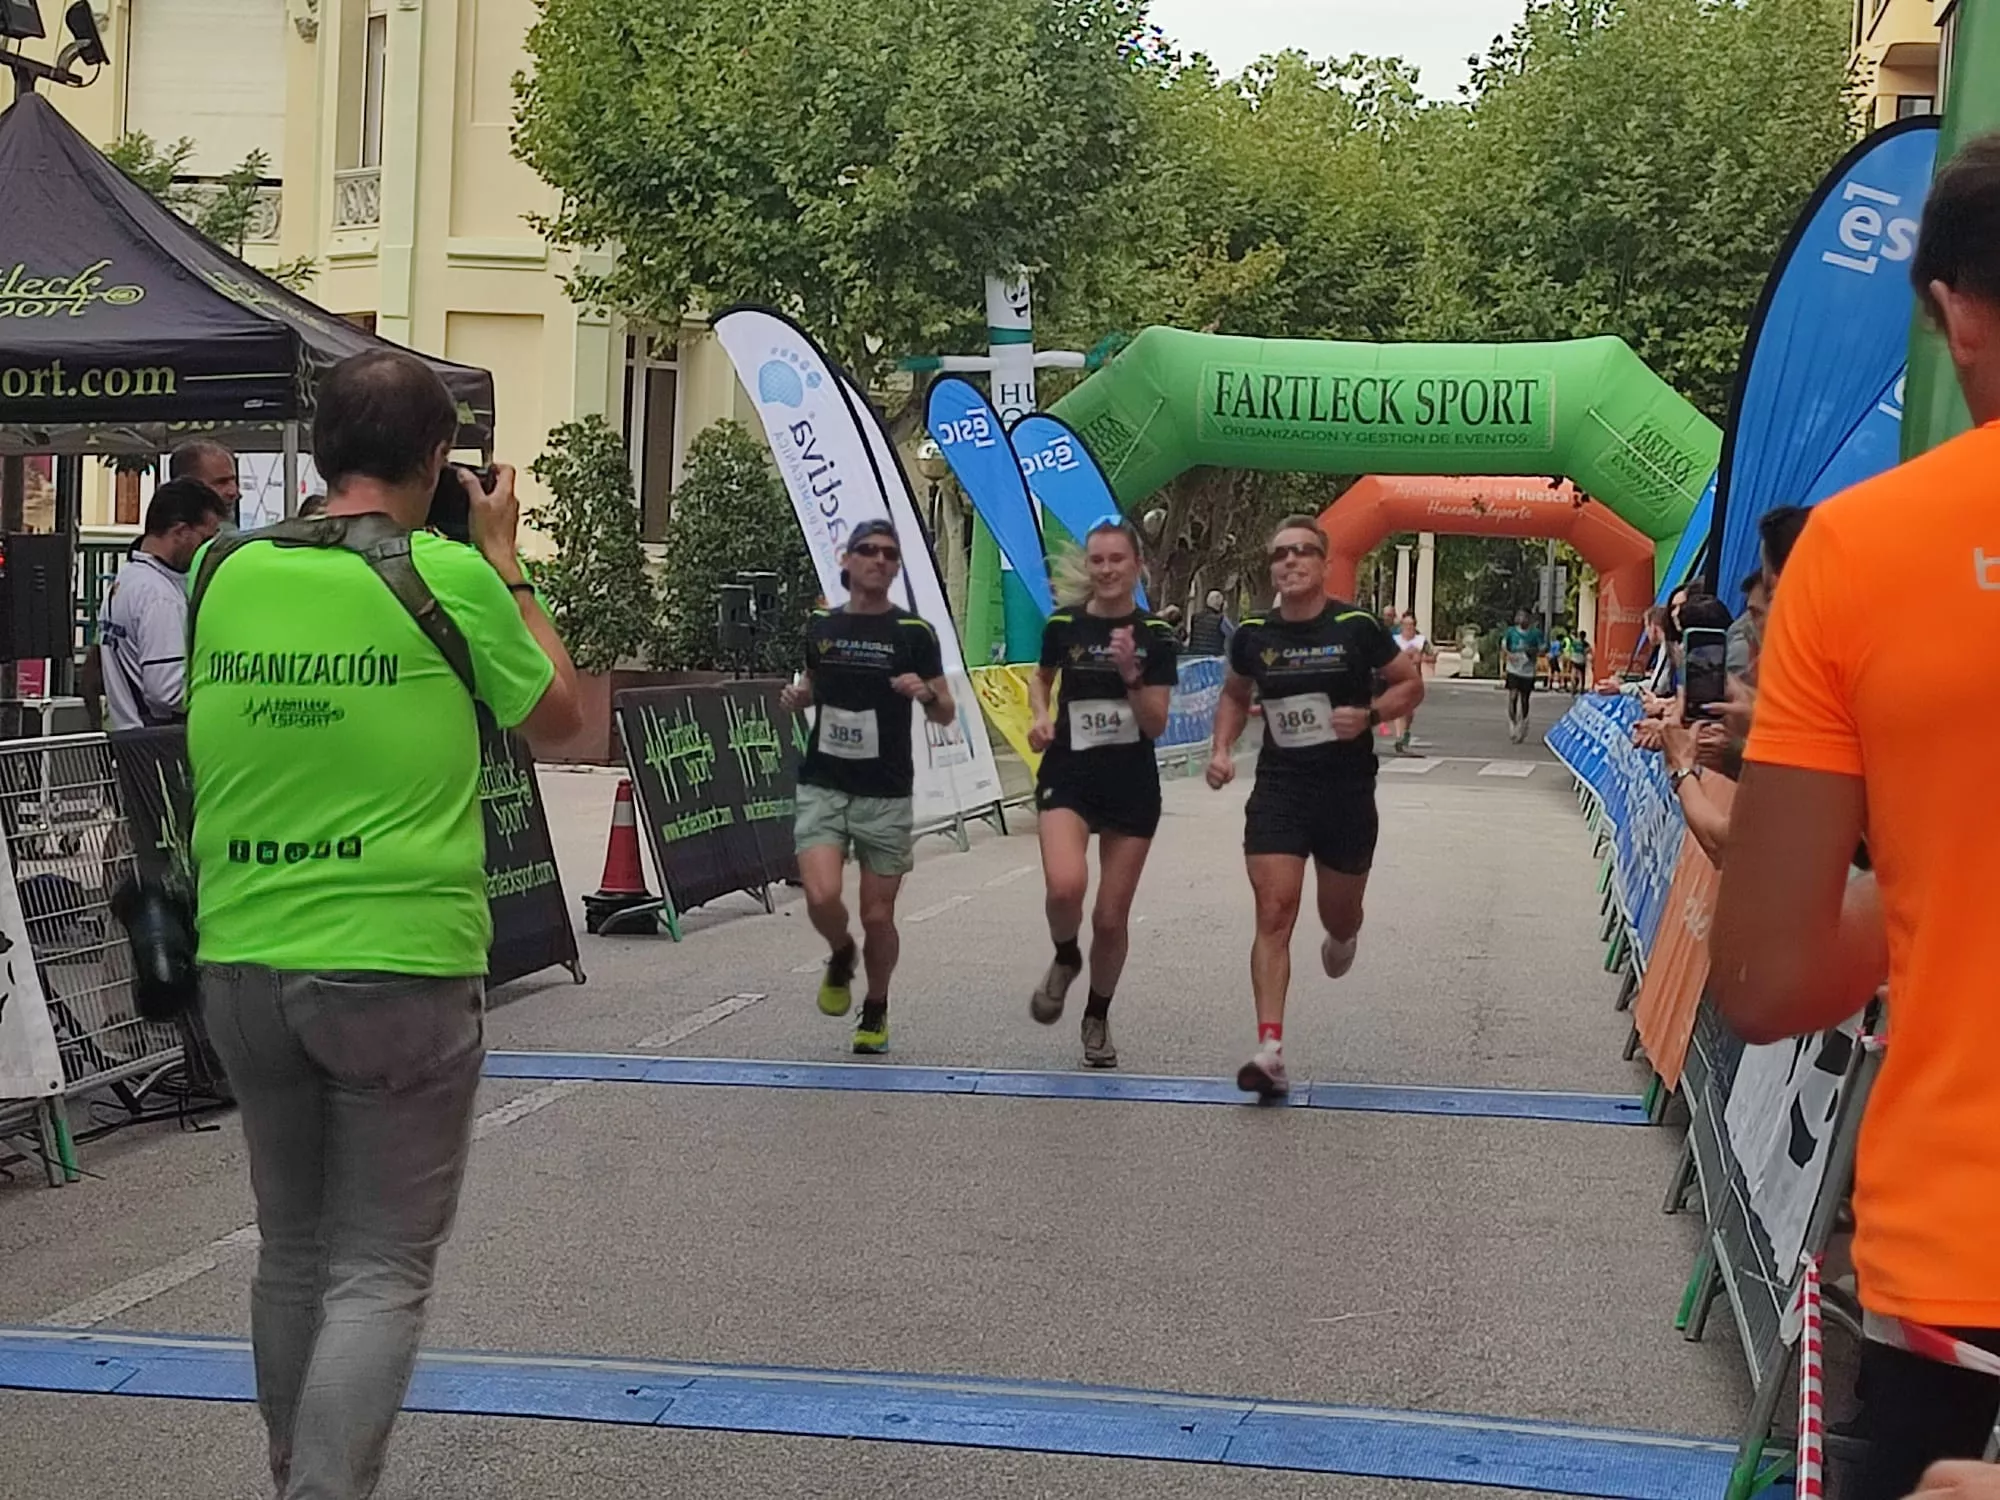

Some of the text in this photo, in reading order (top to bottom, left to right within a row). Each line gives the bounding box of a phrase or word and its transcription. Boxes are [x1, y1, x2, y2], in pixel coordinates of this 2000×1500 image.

[1213, 370, 1539, 426] FARTLECK SPORT
[1428, 432, 1450, 444] DE
[1516, 488, 1569, 503] Huesca
[210, 645, 398, 687] ORGANIZACIÓN
[1081, 711, 1123, 731] 384
[1276, 707, 1316, 729] 386
[829, 723, 864, 744] 385
